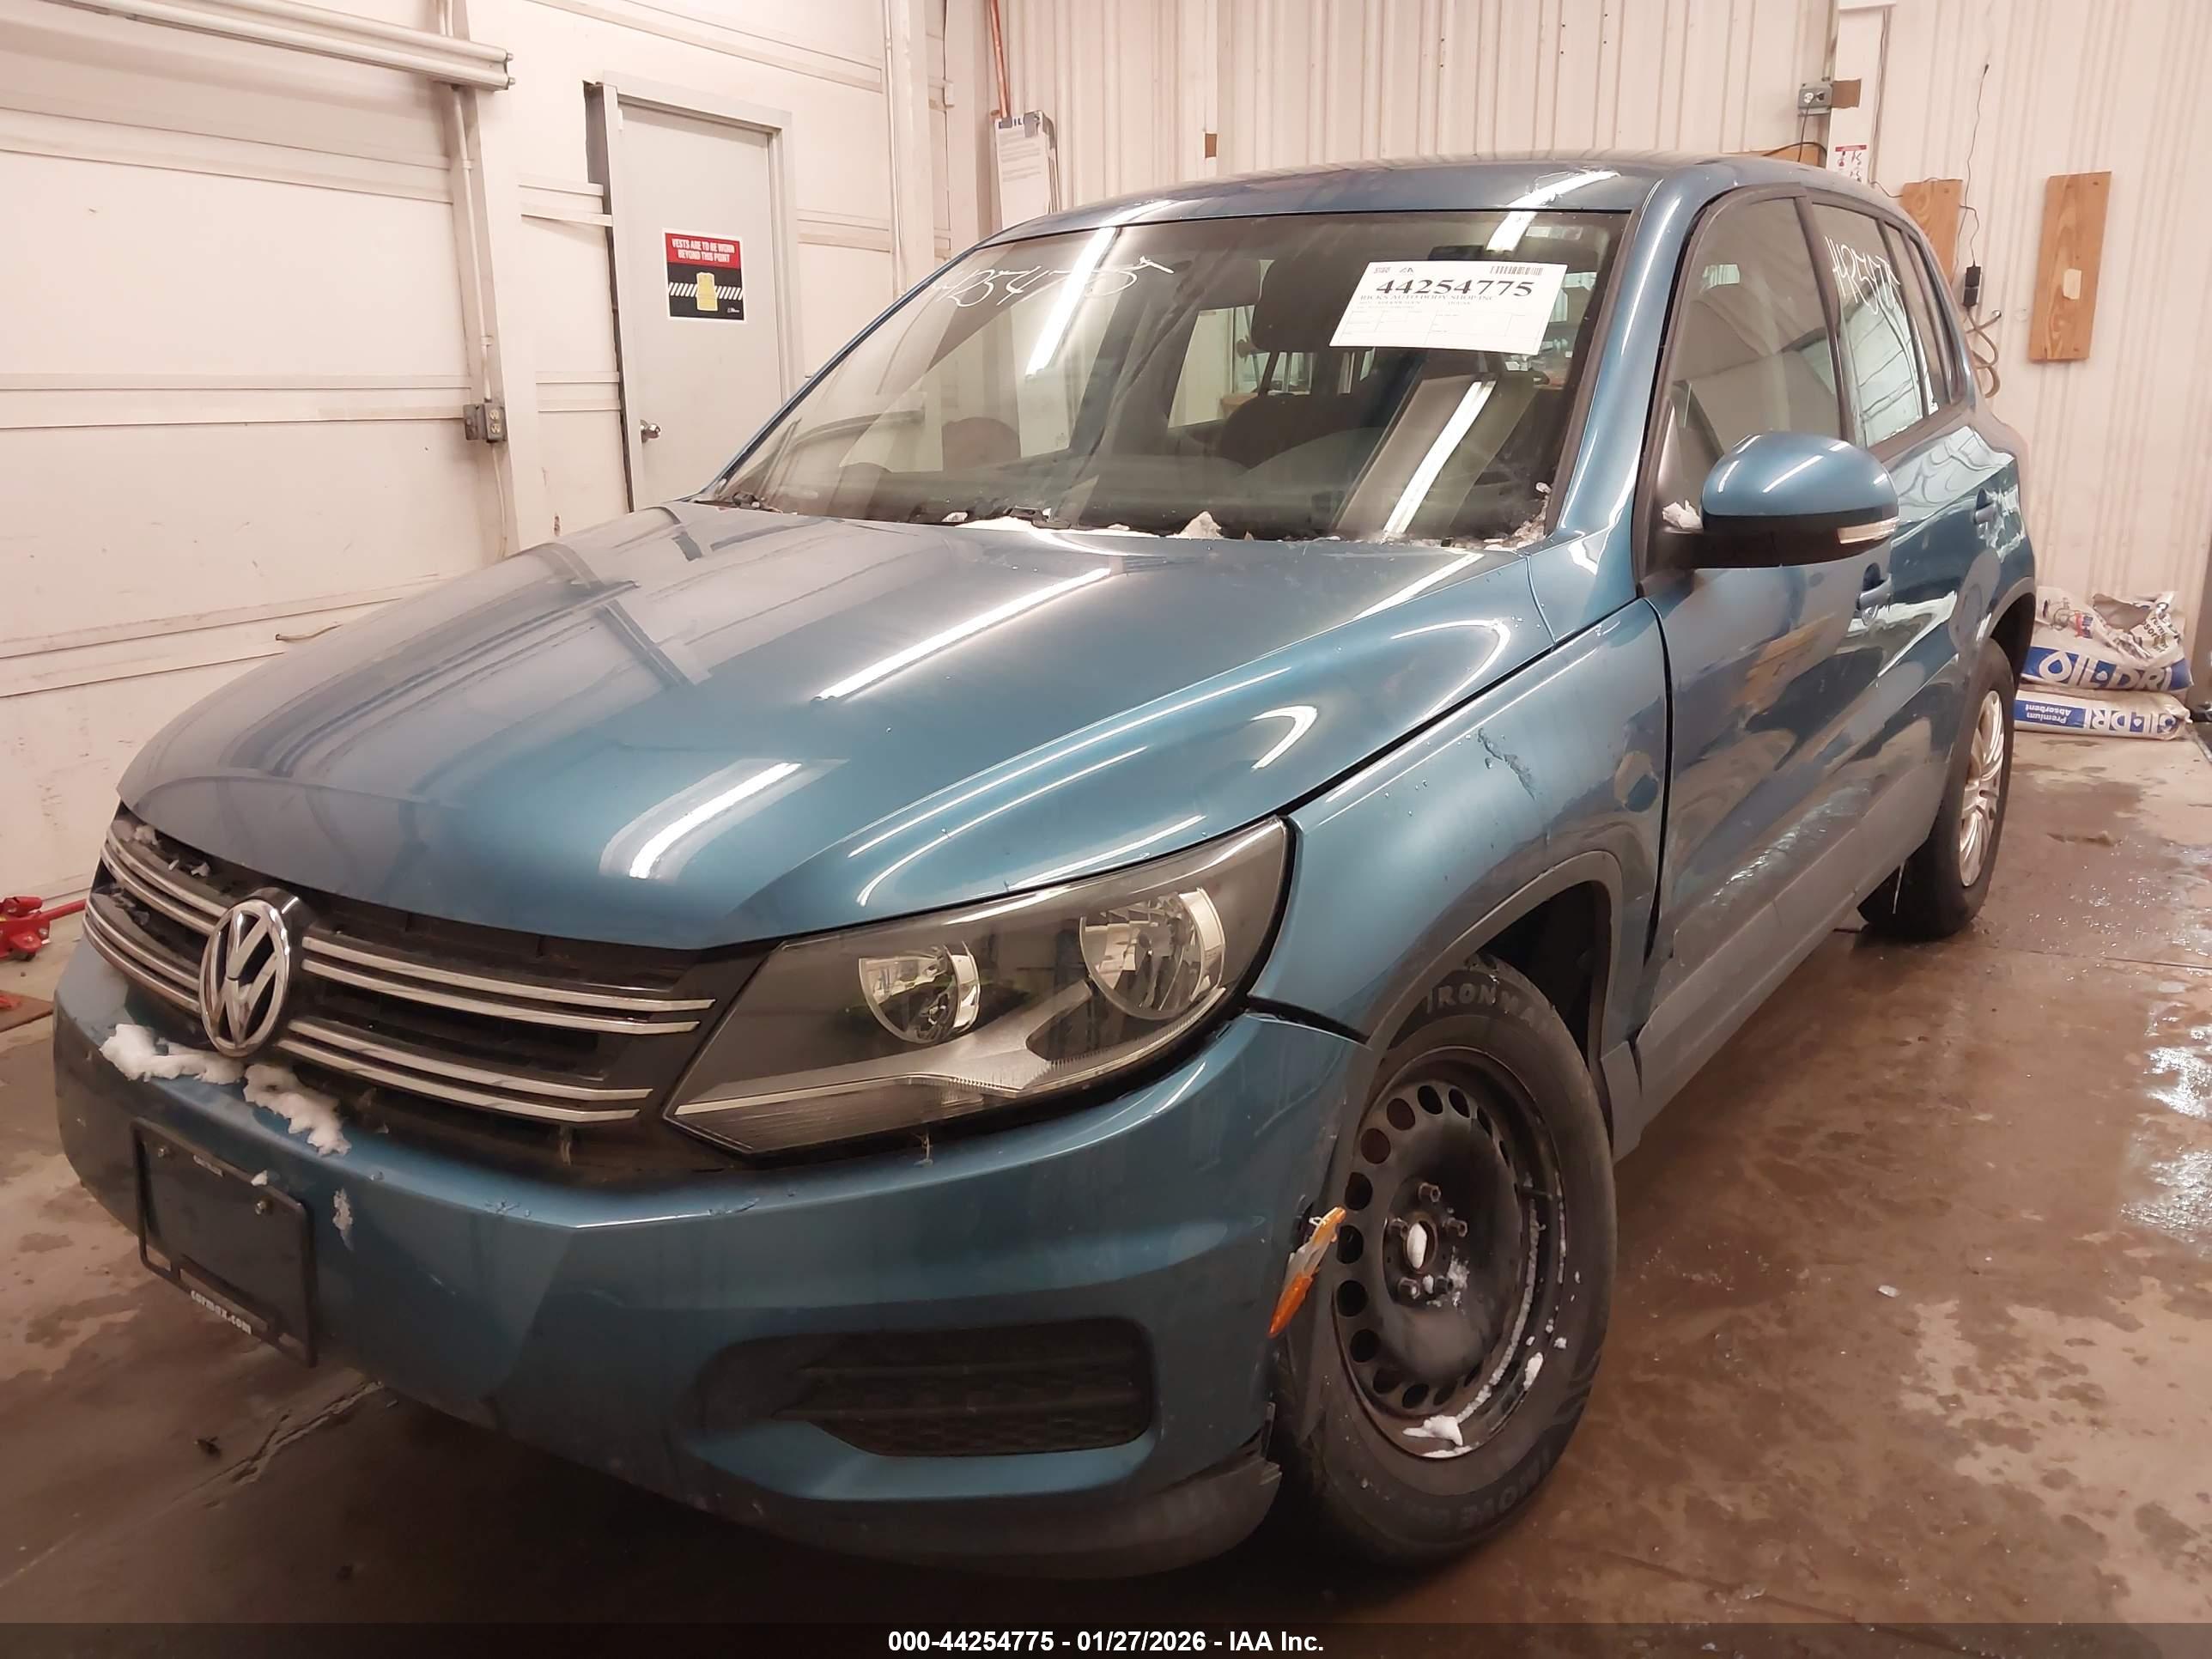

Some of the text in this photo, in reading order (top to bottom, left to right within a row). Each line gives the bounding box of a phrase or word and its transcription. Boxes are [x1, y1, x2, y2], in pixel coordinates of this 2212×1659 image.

[672, 238, 735, 254] VESTS ARE TO BE WORN
[678, 249, 730, 263] BEYOND THIS POINT
[1376, 279, 1535, 297] 44254775
[2025, 703, 2071, 717] Absorbent
[2026, 711, 2068, 725] Premium
[1425, 982, 1551, 1030] IRONMA
